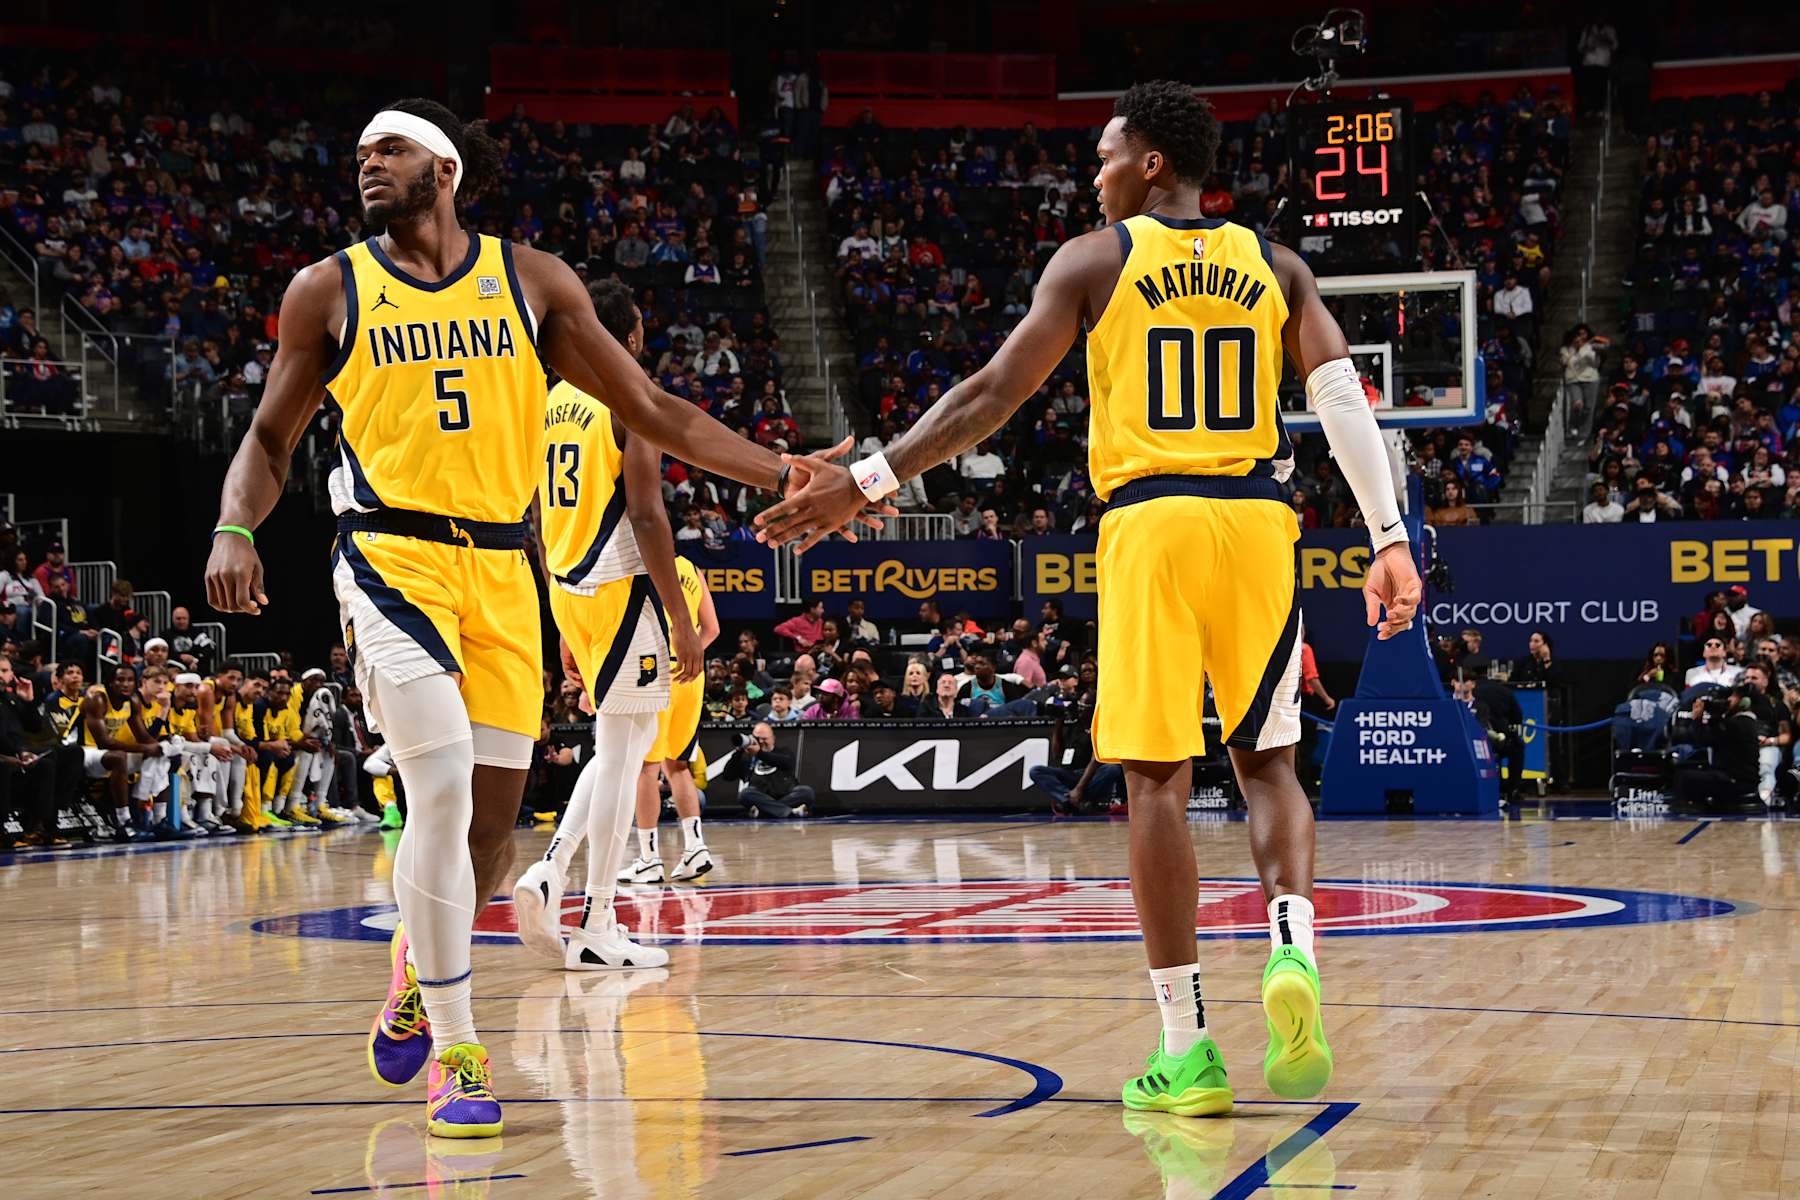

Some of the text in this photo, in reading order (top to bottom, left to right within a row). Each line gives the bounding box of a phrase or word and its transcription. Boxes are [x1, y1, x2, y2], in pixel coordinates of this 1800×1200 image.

[1327, 112, 1393, 144] 2:06
[1315, 144, 1388, 200] 24
[1329, 208, 1403, 227] TISSOT
[1134, 262, 1267, 312] MATHURIN
[368, 317, 516, 368] INDIANA
[1147, 326, 1256, 431] 00
[433, 368, 471, 432] 5
[545, 442, 581, 508] 13
[1670, 538, 1800, 583] BET
[811, 559, 998, 599] BETRIVERS
[1581, 599, 1660, 623] CLUB
[1354, 711, 1432, 727] HENRY
[1360, 730, 1416, 746] FORD
[1360, 748, 1447, 765] HEALTH
[1187, 797, 1229, 809] aesars
[1191, 786, 1224, 798] Little
